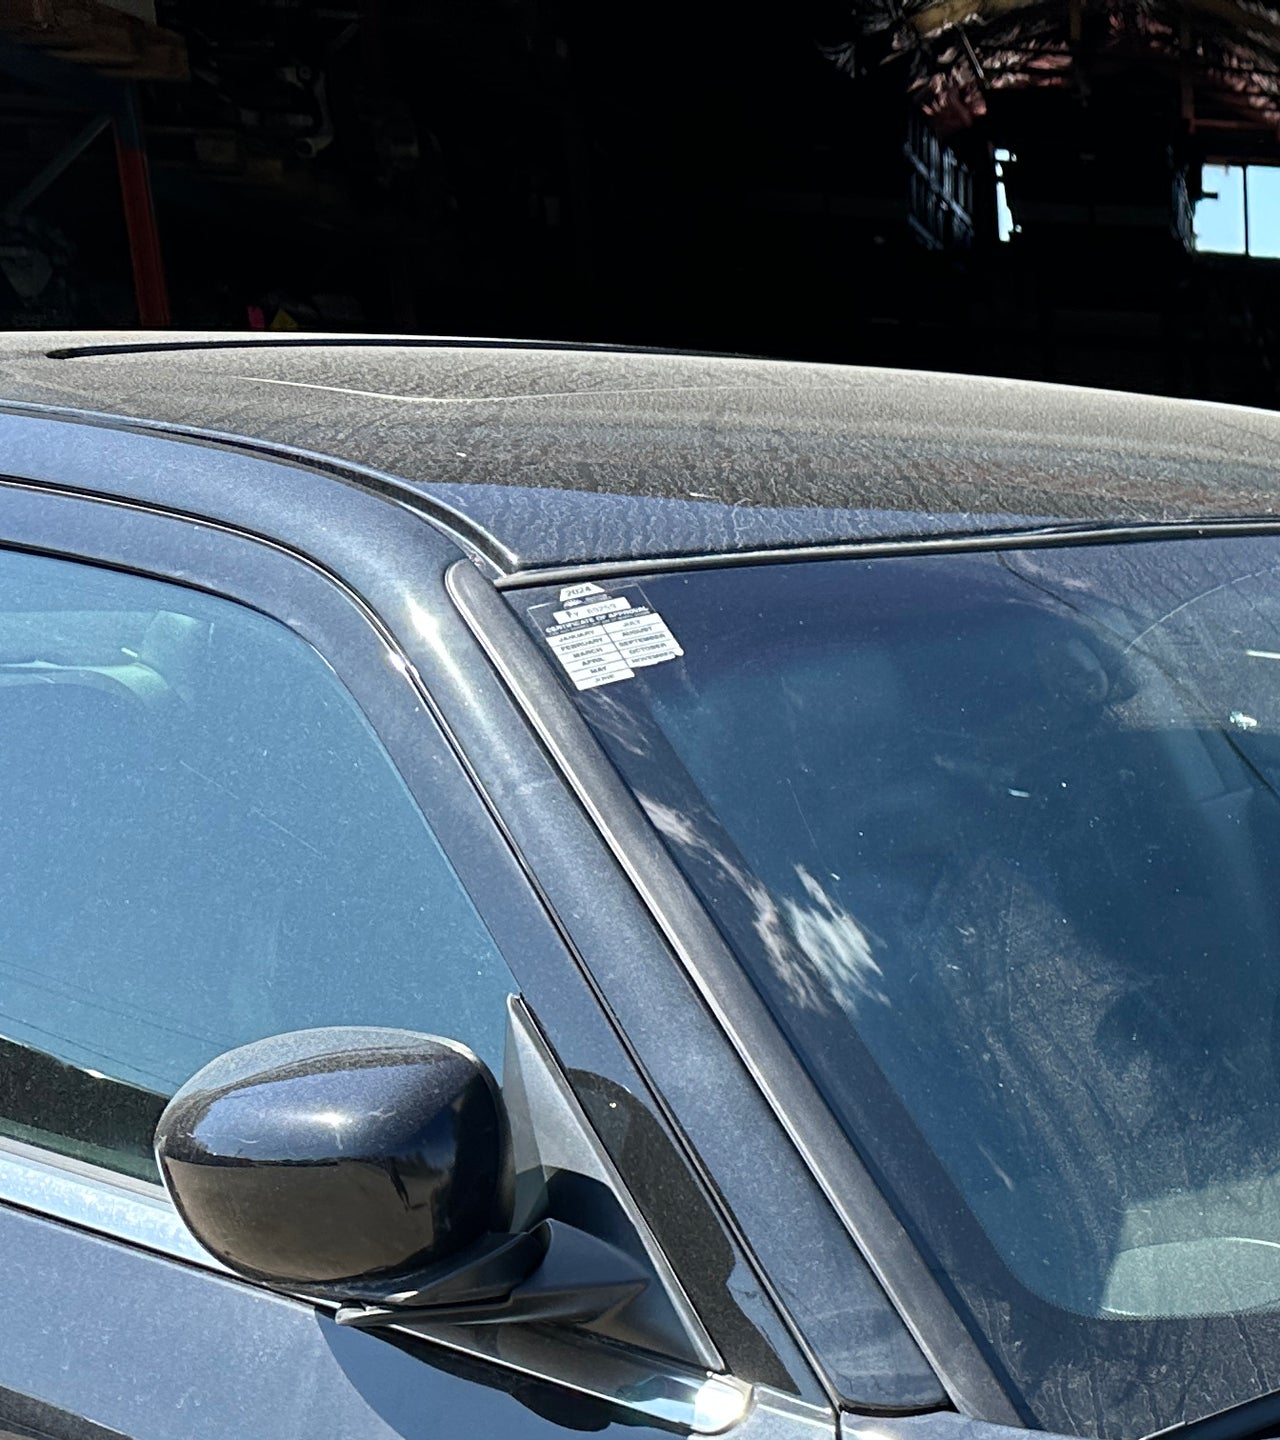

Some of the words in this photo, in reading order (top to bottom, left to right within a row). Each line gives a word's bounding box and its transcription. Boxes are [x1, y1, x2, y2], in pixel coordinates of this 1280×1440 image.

[559, 630, 595, 643] JANUARY
[622, 626, 653, 637] AUGUST
[560, 638, 603, 652] FEBRUARY
[619, 633, 667, 647] SEPTEMBER
[573, 648, 604, 659] MARCH
[628, 643, 667, 655] OCTOBER
[581, 657, 606, 667] APRIL
[589, 666, 608, 674] MAY
